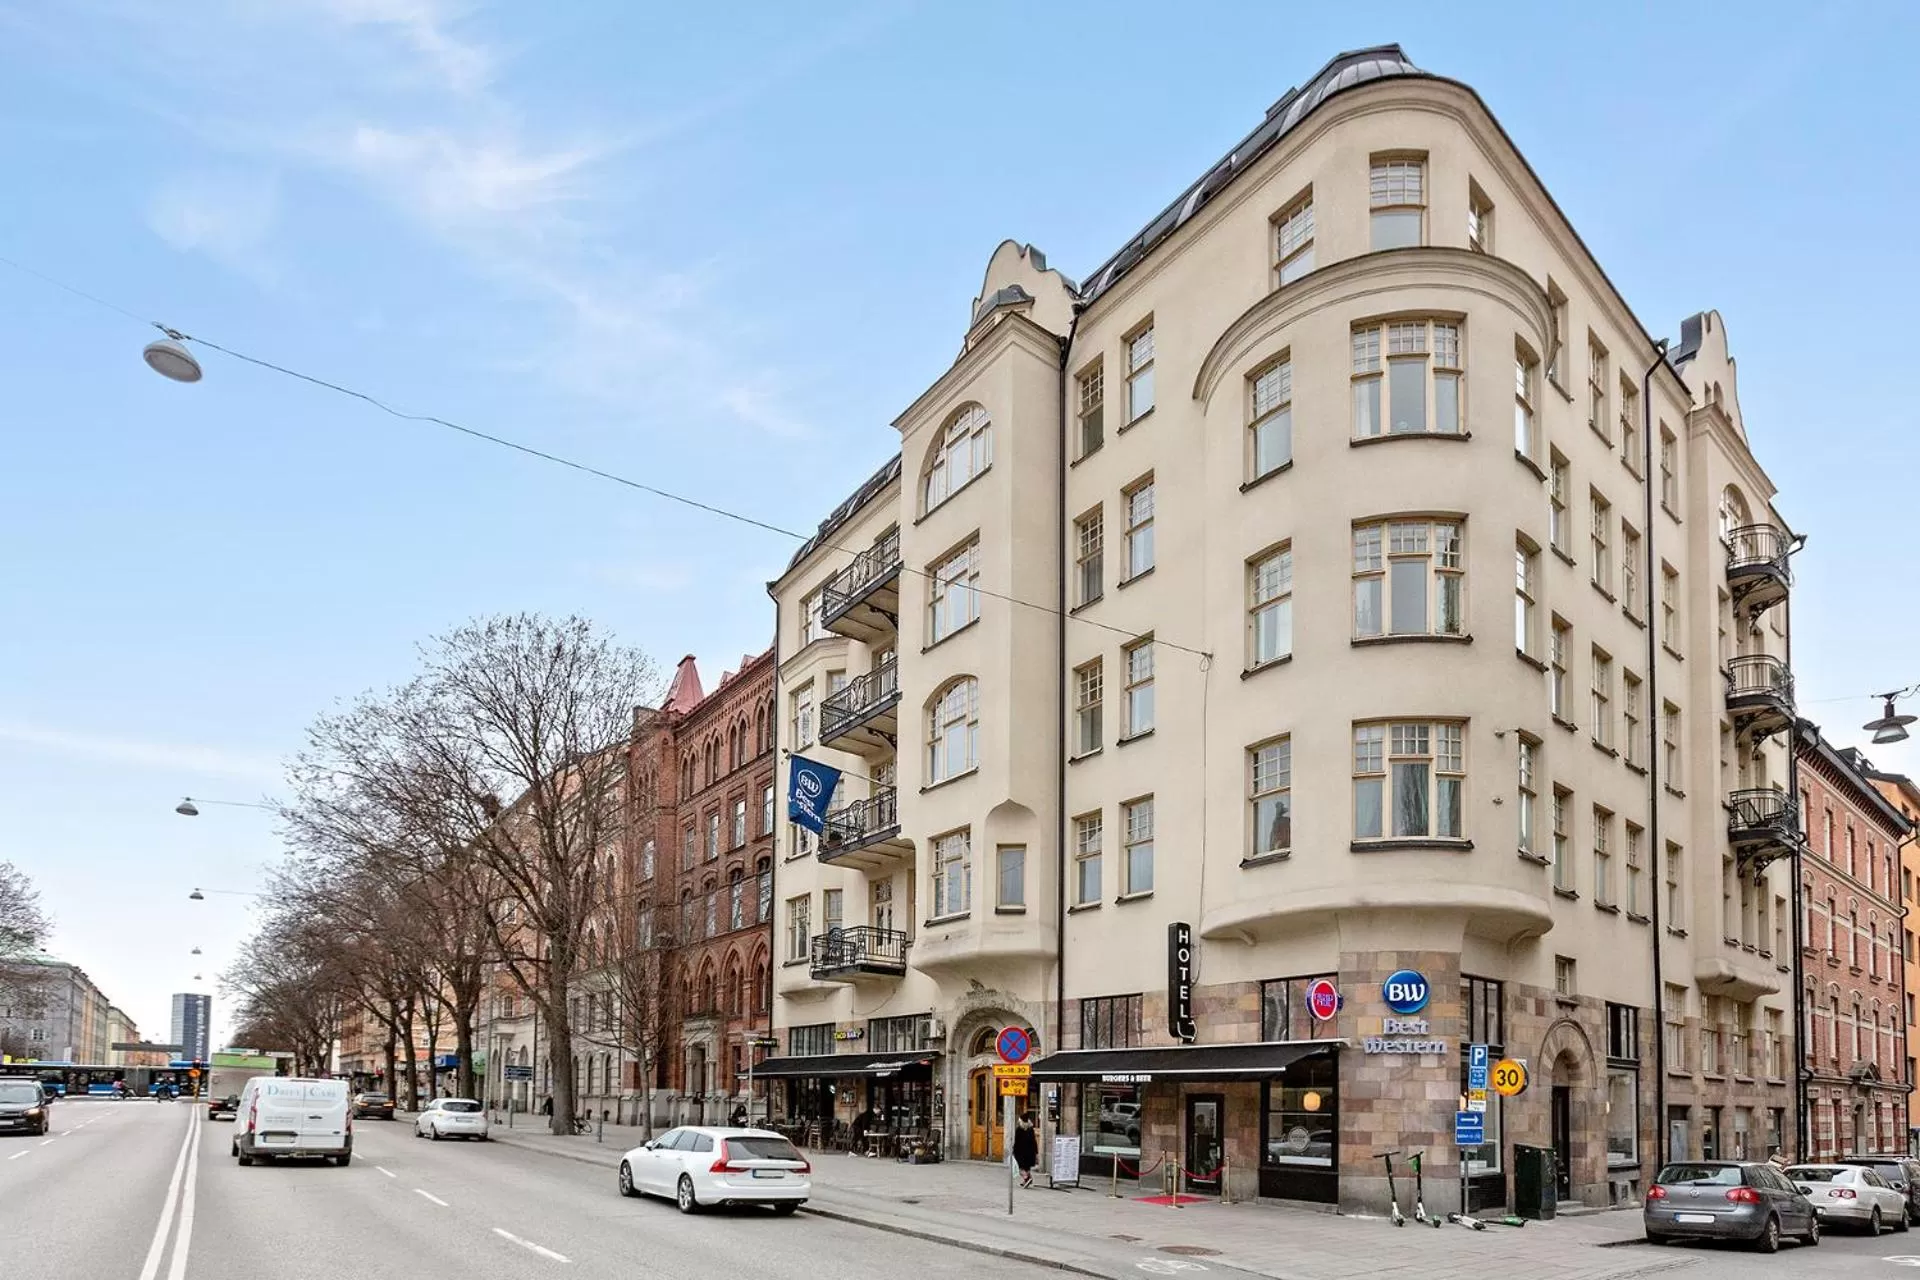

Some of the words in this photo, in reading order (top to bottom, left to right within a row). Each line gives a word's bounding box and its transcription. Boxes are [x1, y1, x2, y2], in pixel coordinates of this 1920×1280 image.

[800, 774, 819, 793] BW
[1178, 930, 1190, 1018] HOTEL
[1388, 983, 1426, 1002] BW
[1383, 1018, 1429, 1035] Best
[1362, 1036, 1448, 1054] Western
[1474, 1047, 1485, 1066] P
[1496, 1069, 1519, 1087] 30
